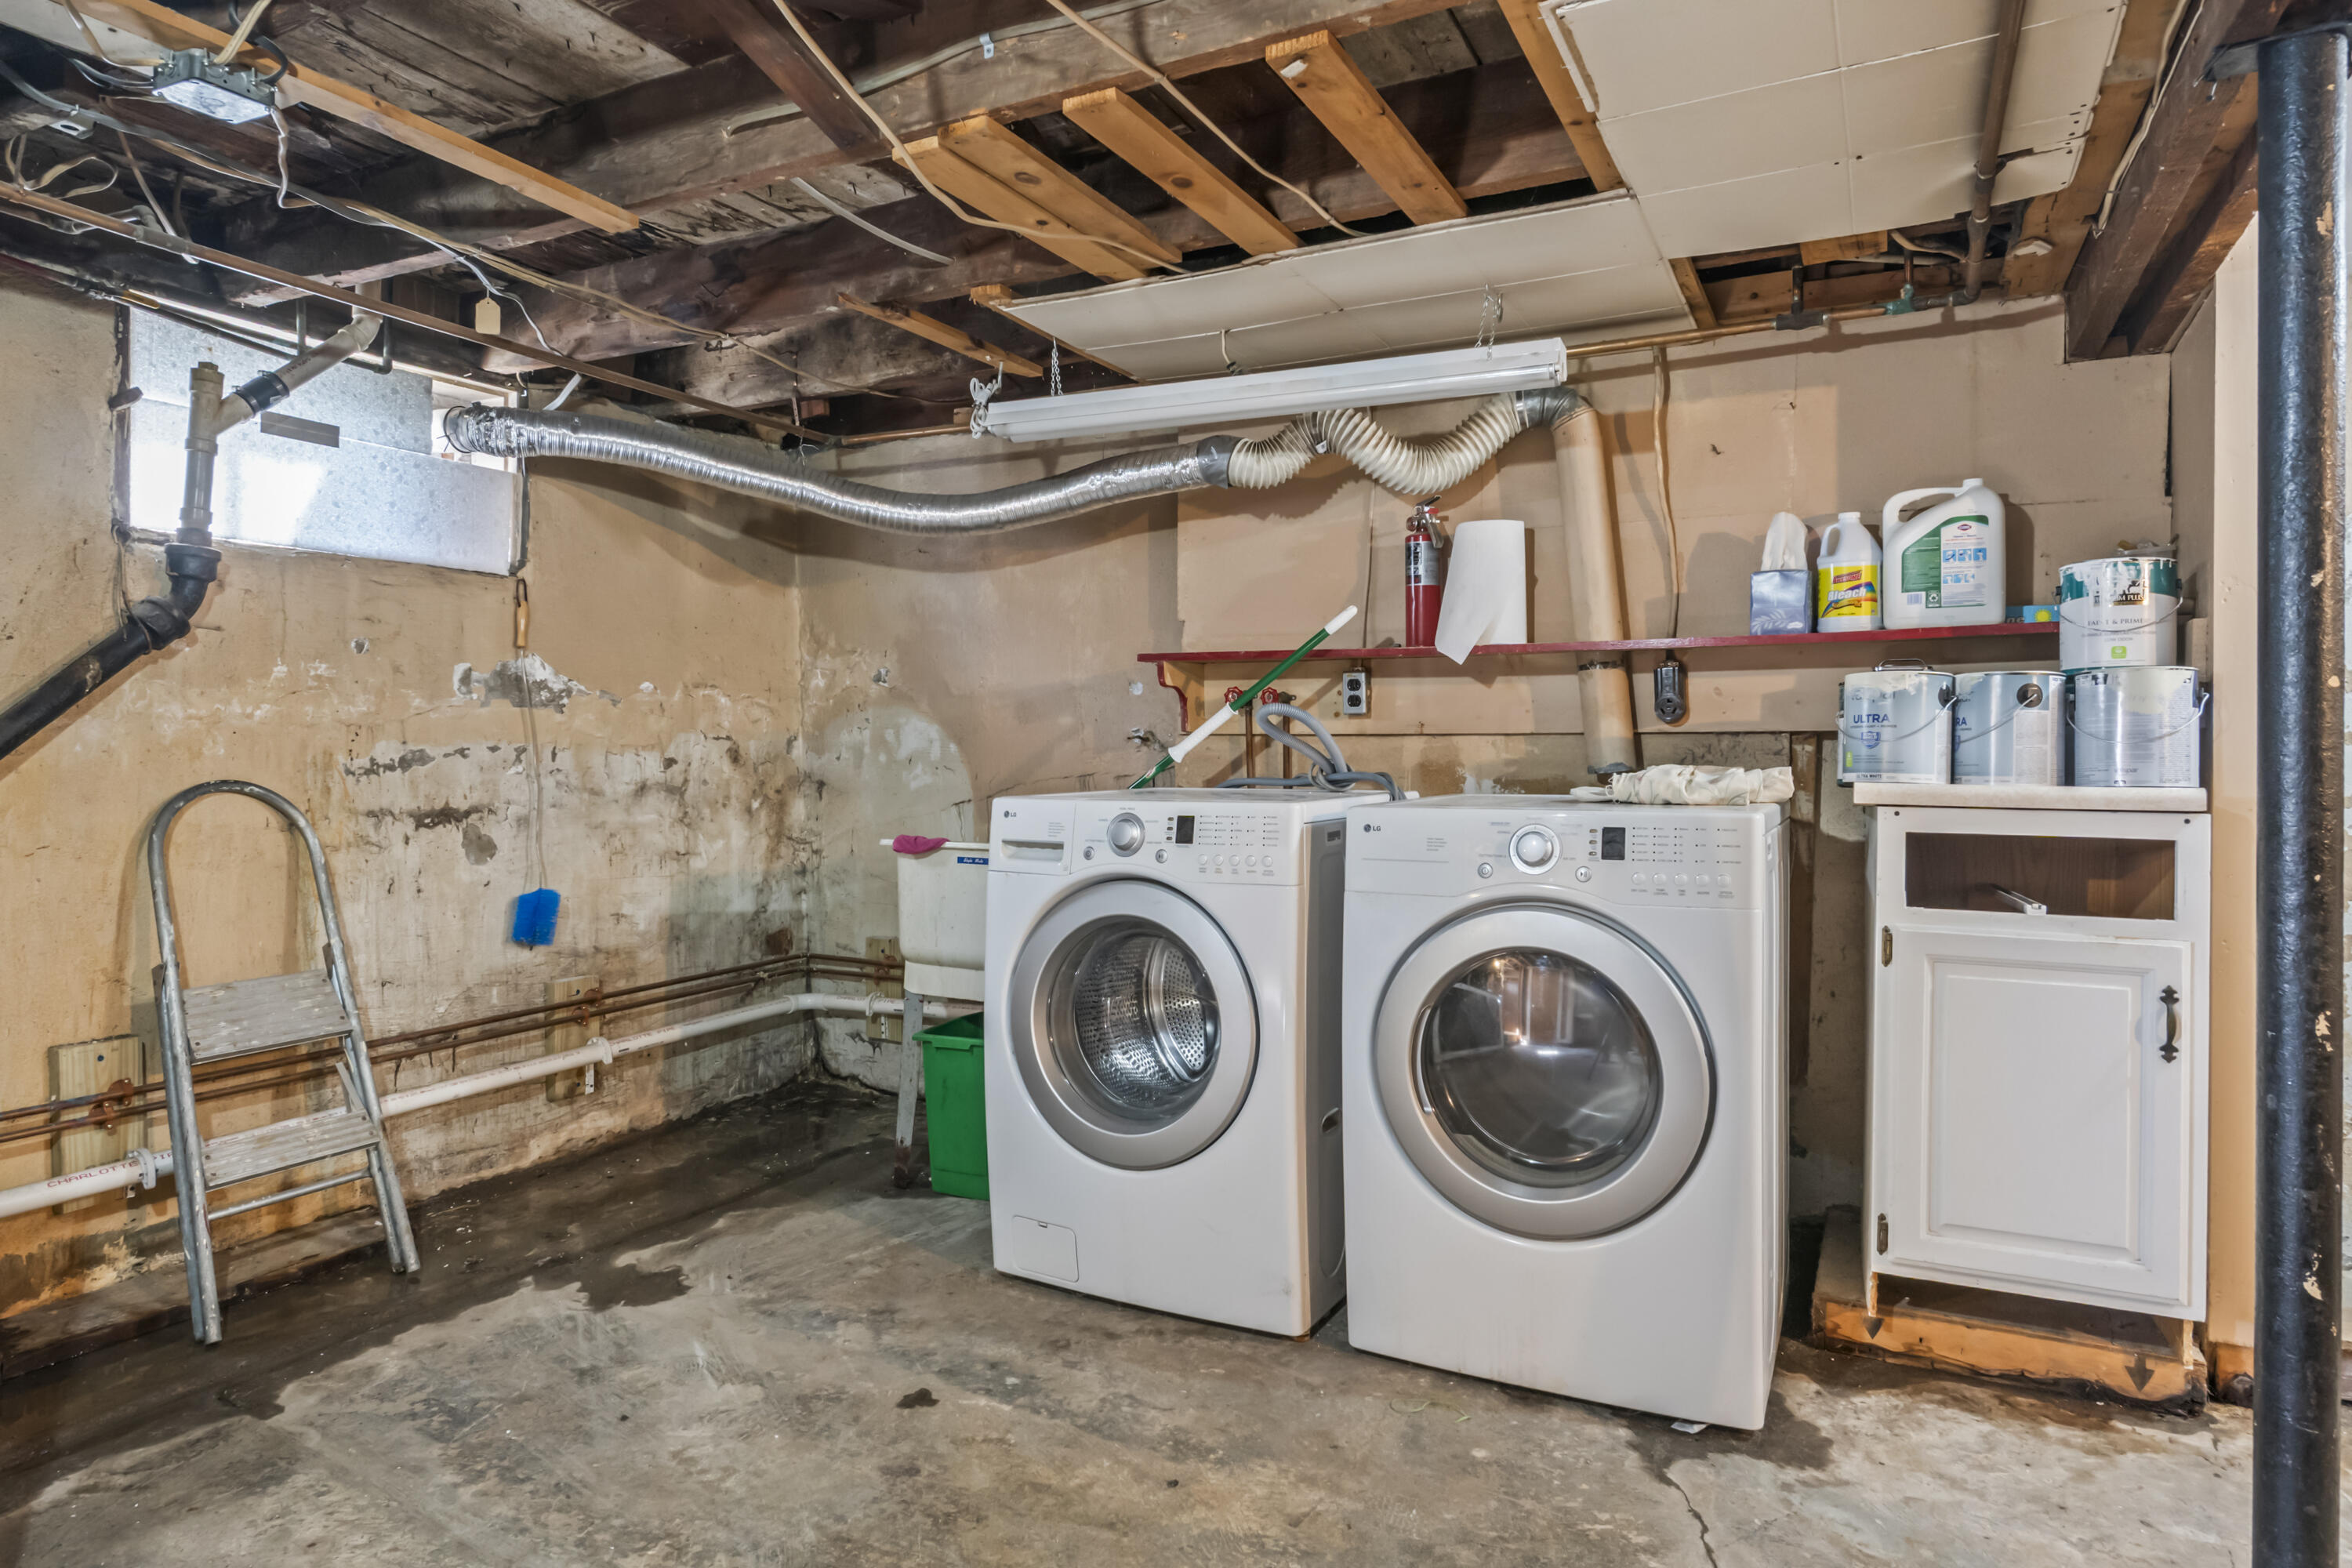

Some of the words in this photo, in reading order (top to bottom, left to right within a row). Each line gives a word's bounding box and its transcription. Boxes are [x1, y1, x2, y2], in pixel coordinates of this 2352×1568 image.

[1828, 586, 1866, 601] Bleach
[1853, 713, 1890, 724] ULTRA
[47, 1160, 140, 1188] CHARLOTTE
